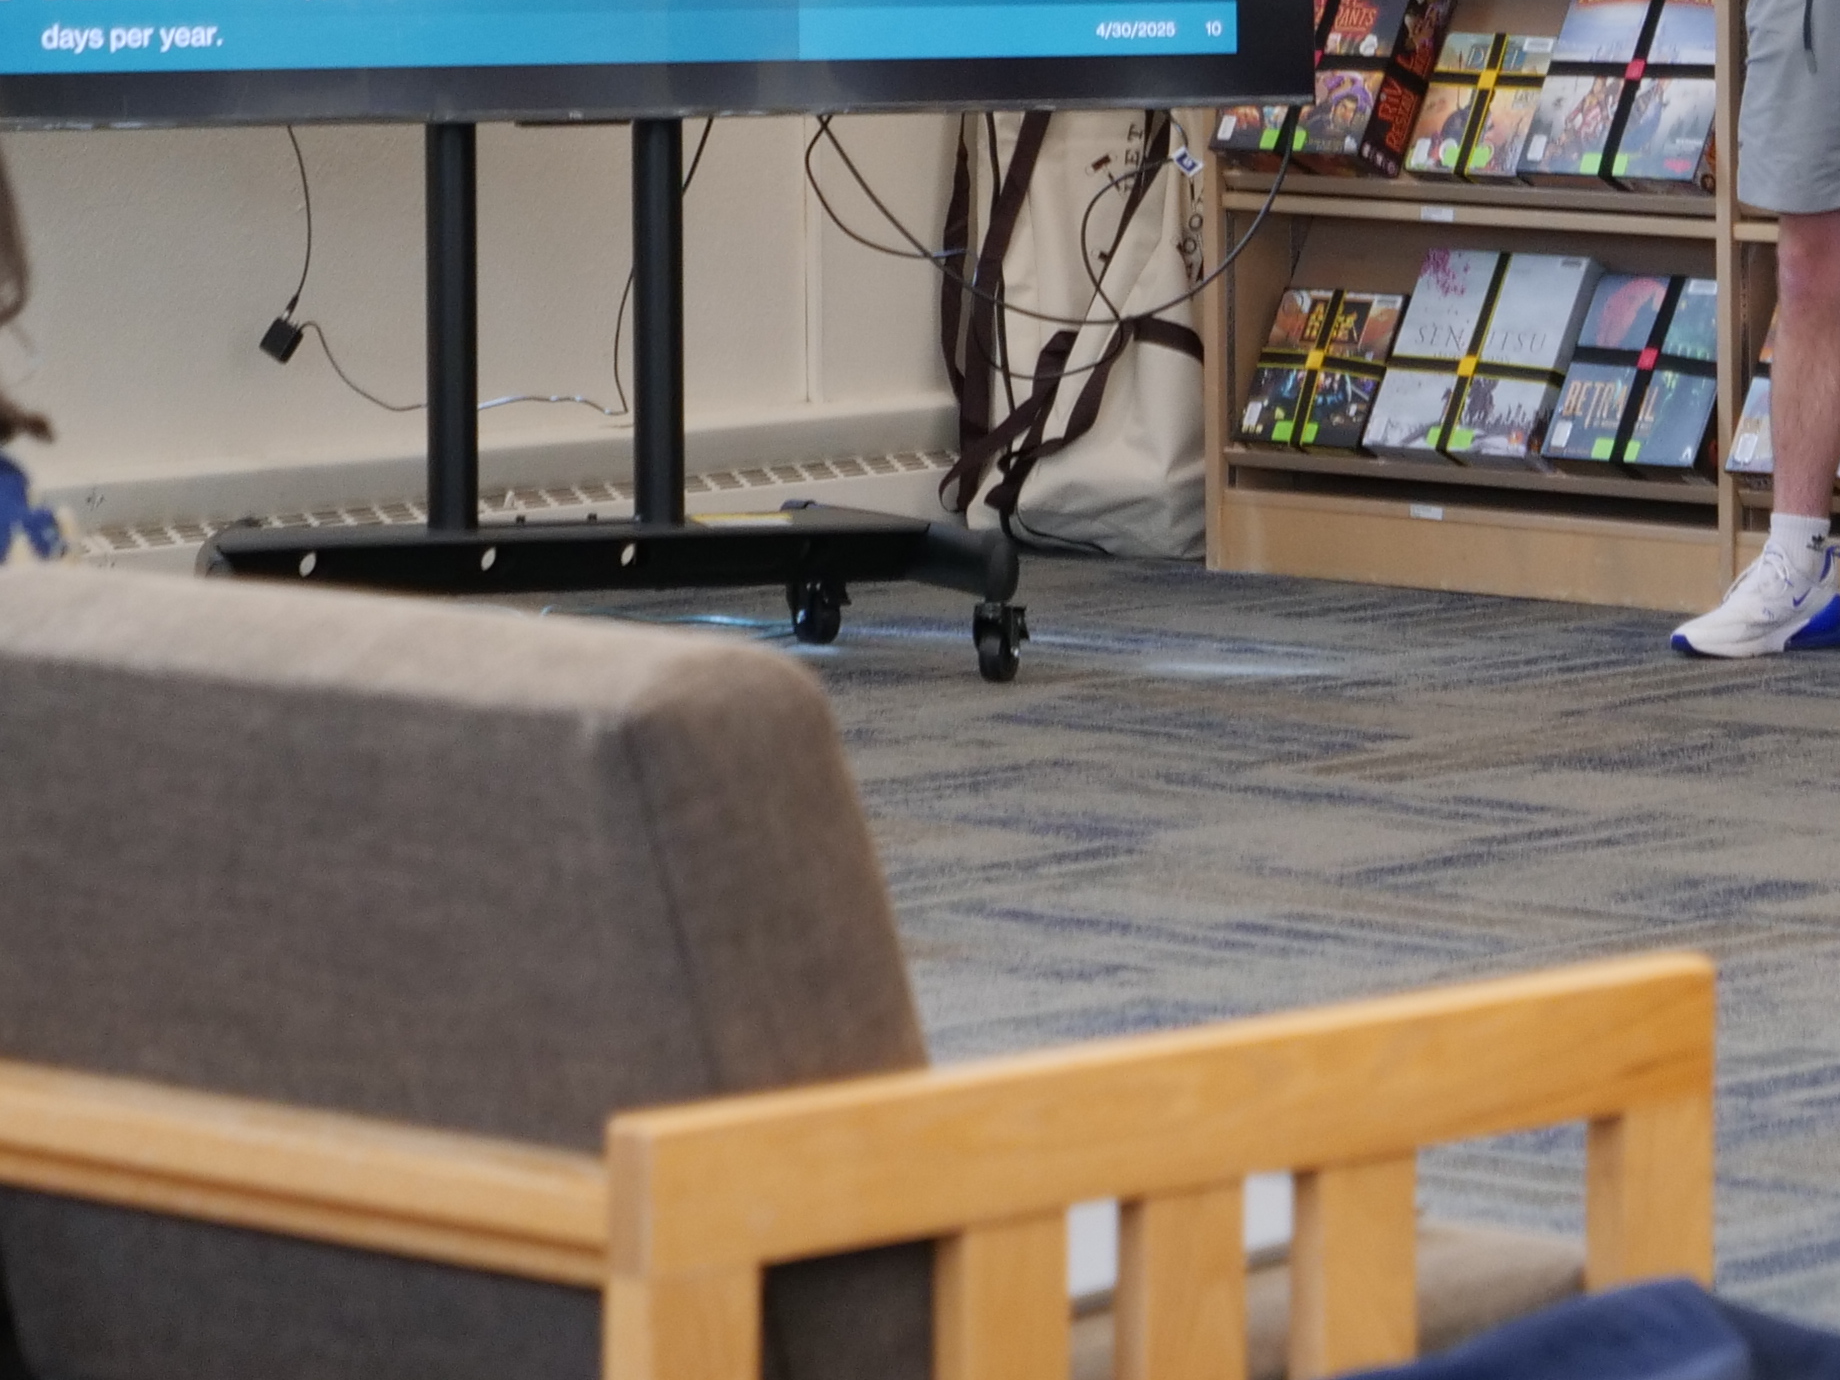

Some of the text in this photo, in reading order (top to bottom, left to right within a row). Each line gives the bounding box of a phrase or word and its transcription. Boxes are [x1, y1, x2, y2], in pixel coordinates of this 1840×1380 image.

[42, 24, 223, 53] days per year.
[1096, 21, 1222, 40] 4/30/2025 10
